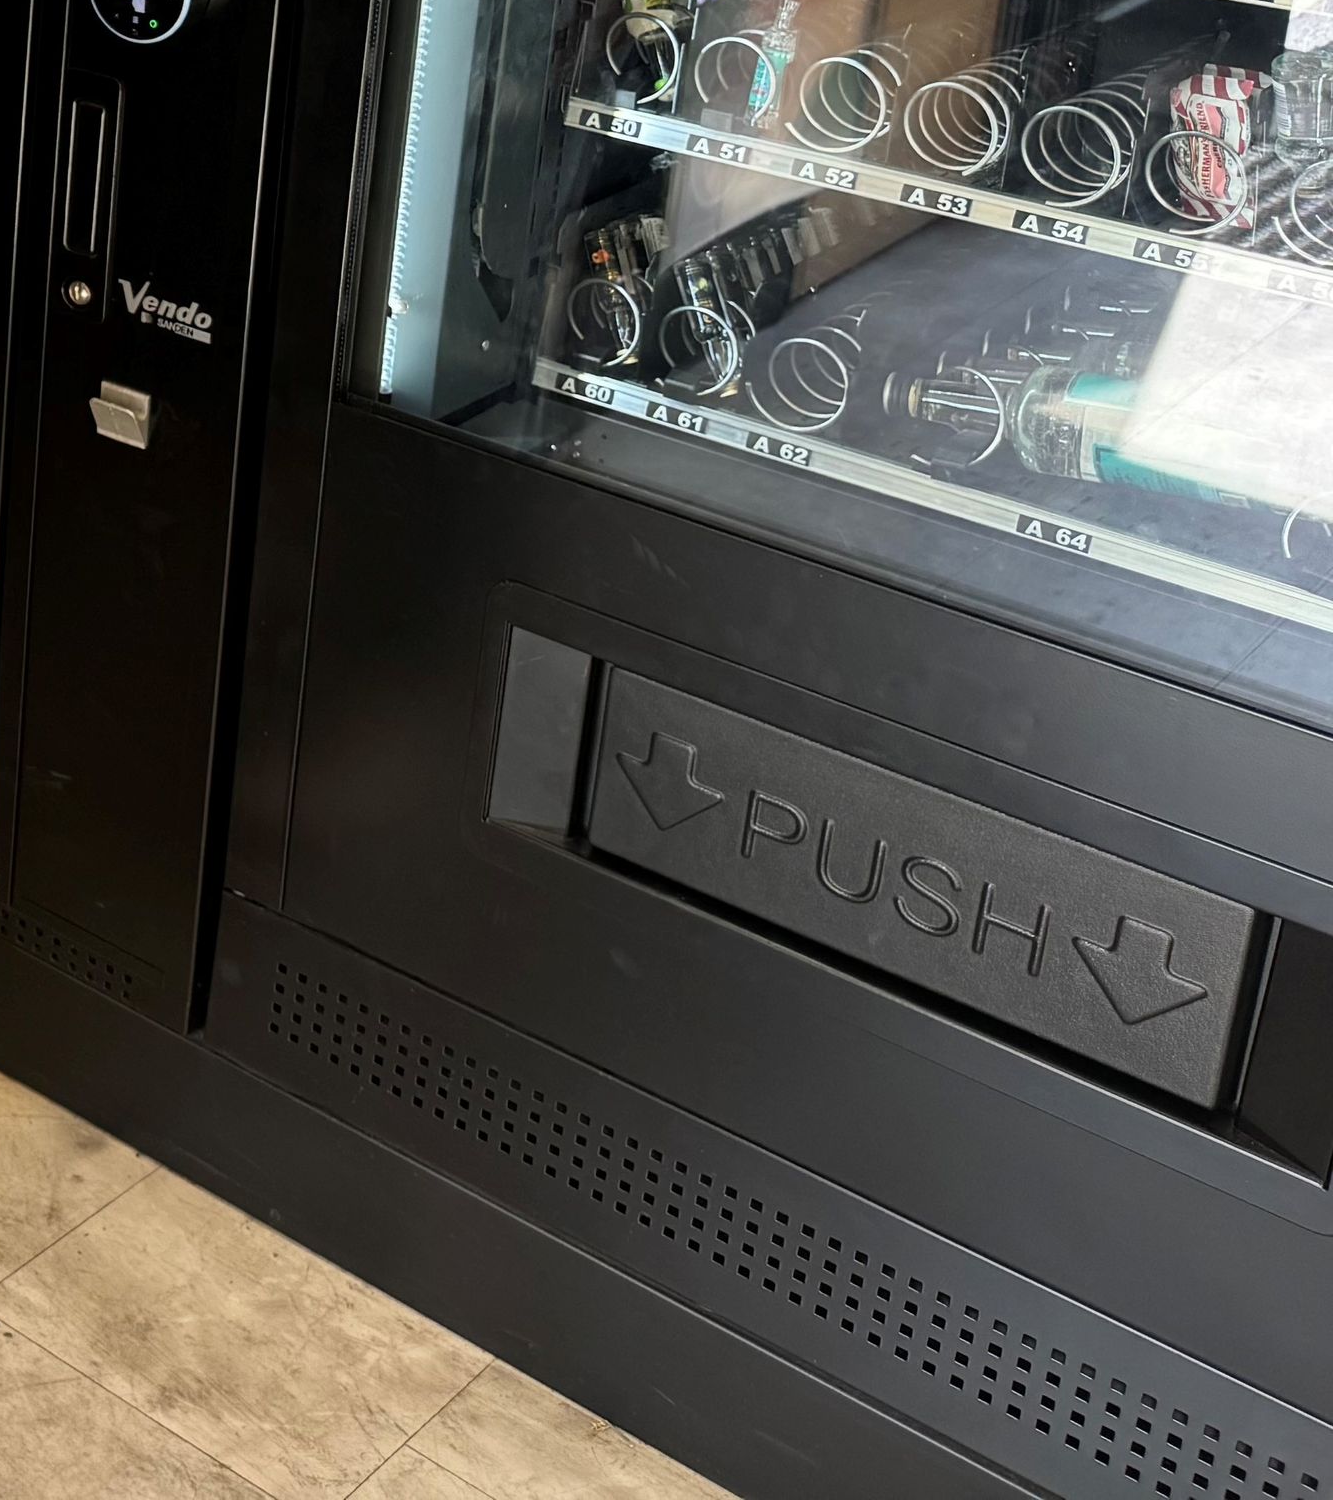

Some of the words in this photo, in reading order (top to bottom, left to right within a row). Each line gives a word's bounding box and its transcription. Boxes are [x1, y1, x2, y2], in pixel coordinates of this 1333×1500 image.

[585, 113, 601, 129] A
[610, 117, 635, 134] 50
[693, 139, 709, 155] A
[719, 143, 746, 162] 51
[798, 162, 815, 180] A
[824, 167, 854, 188] 52
[907, 188, 926, 206] A
[936, 194, 968, 215] 53
[1020, 215, 1039, 233] A
[1051, 221, 1084, 243] 54
[1141, 243, 1162, 262] A
[118, 278, 213, 330] Vendo
[157, 317, 194, 338] SANDEN
[561, 379, 576, 394] A
[584, 383, 612, 404] 60
[652, 406, 668, 422] A
[677, 411, 704, 432] 61
[753, 436, 769, 453] A
[779, 442, 809, 465] 62
[1025, 520, 1043, 539] A
[1056, 528, 1088, 552] 64
[740, 787, 1052, 978] PUSH
